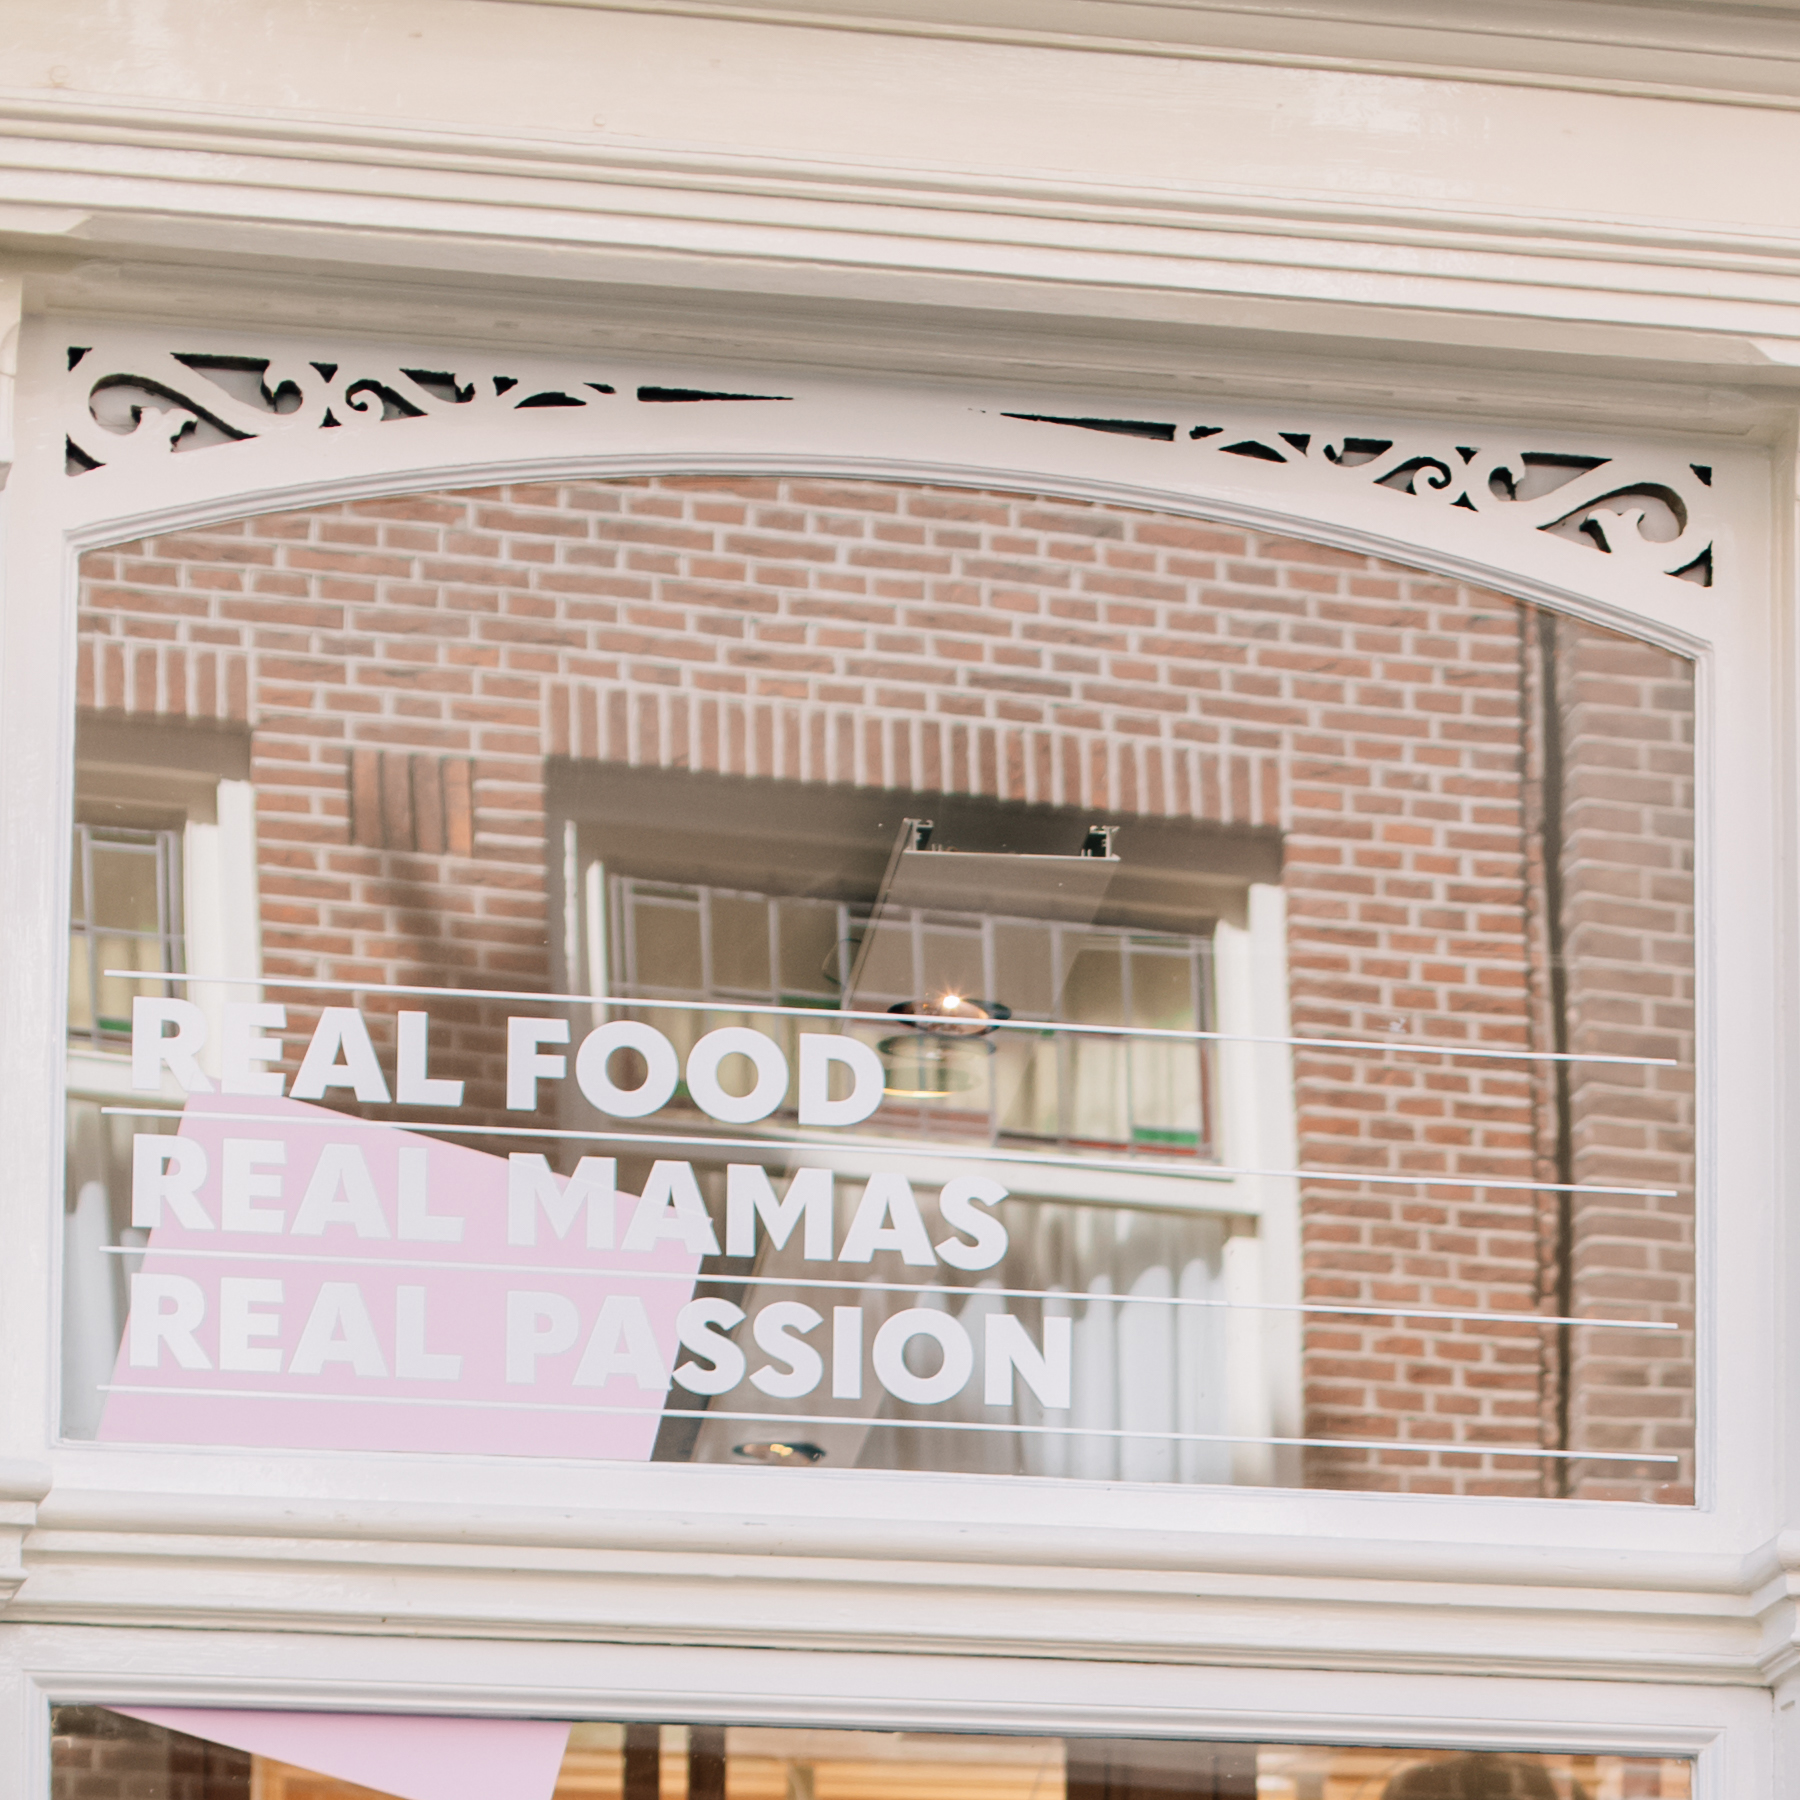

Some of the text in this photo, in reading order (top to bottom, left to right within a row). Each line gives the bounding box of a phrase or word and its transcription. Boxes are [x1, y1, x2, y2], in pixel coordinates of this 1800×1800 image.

[132, 996, 886, 1126] REAL FOOD
[132, 1133, 1009, 1271] REAL MAMAS
[129, 1273, 1072, 1409] REAL PASSION
